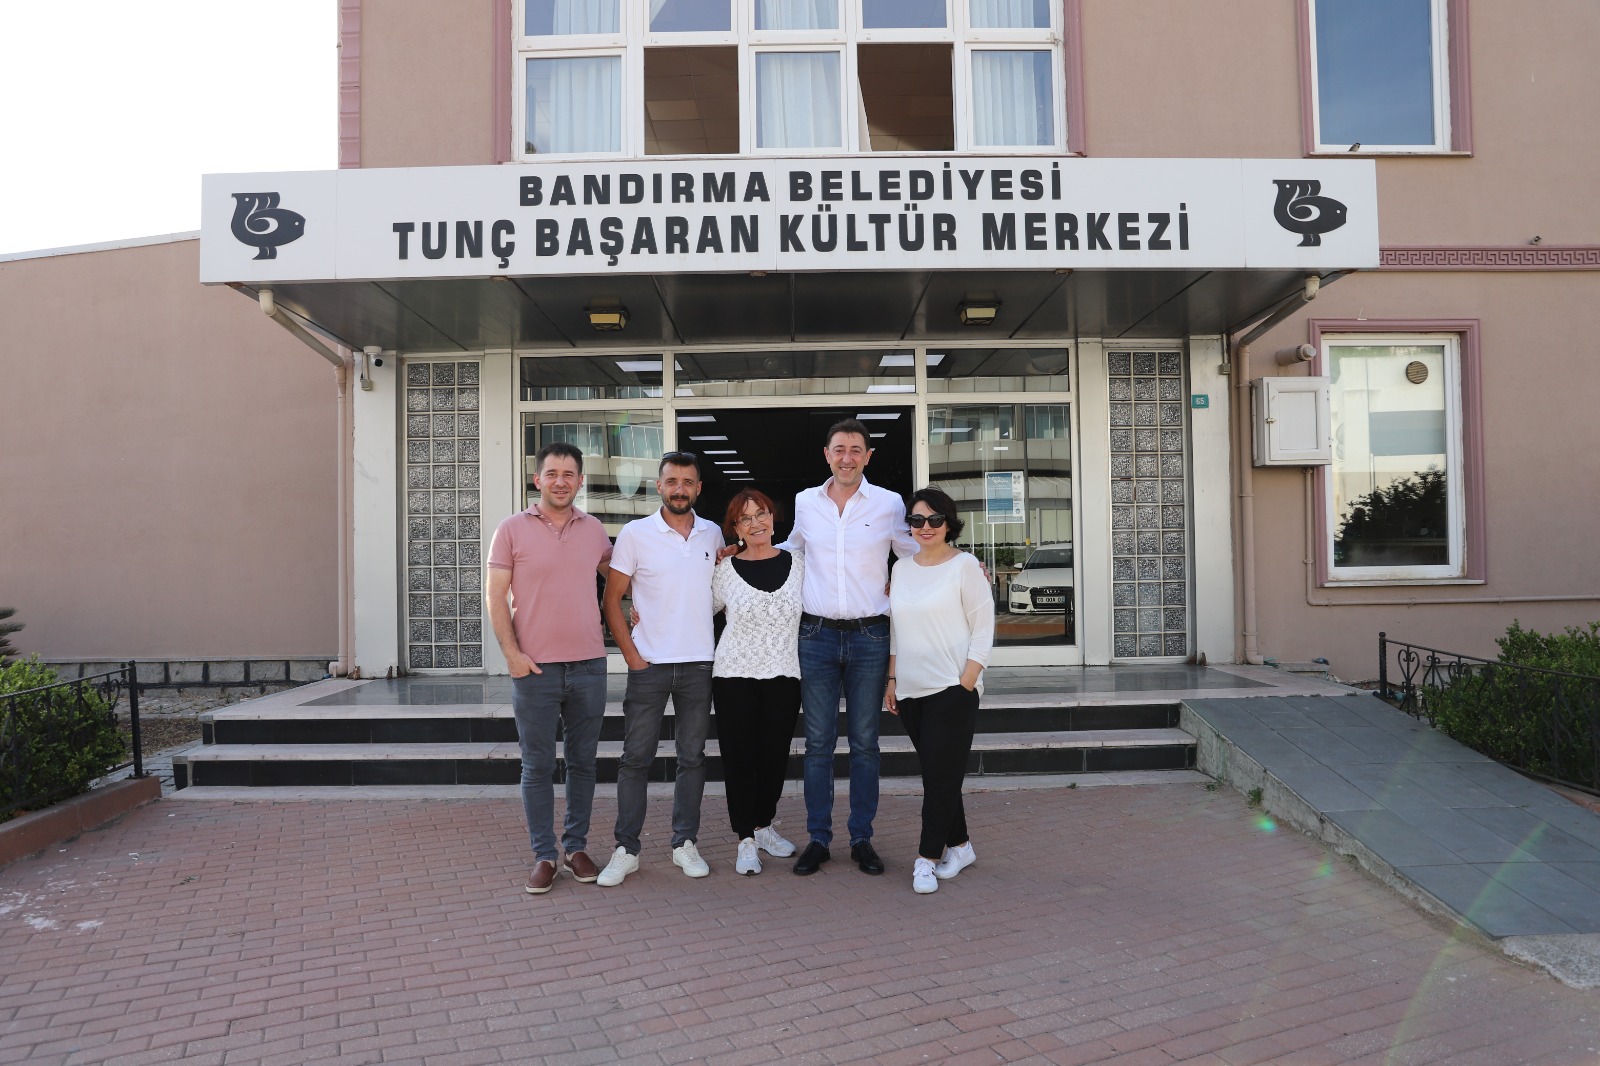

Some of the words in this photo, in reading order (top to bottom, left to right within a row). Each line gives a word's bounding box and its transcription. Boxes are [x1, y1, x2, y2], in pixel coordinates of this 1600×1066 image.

[519, 171, 771, 207] BANDIRMA
[789, 161, 1062, 202] BELEDİYESİ
[392, 219, 516, 269] TUNÇ
[535, 213, 759, 267] BAŞARAN
[779, 202, 957, 253] KÜLTÜR
[982, 202, 1190, 251] MERKEZİ
[1195, 397, 1205, 405] 65
